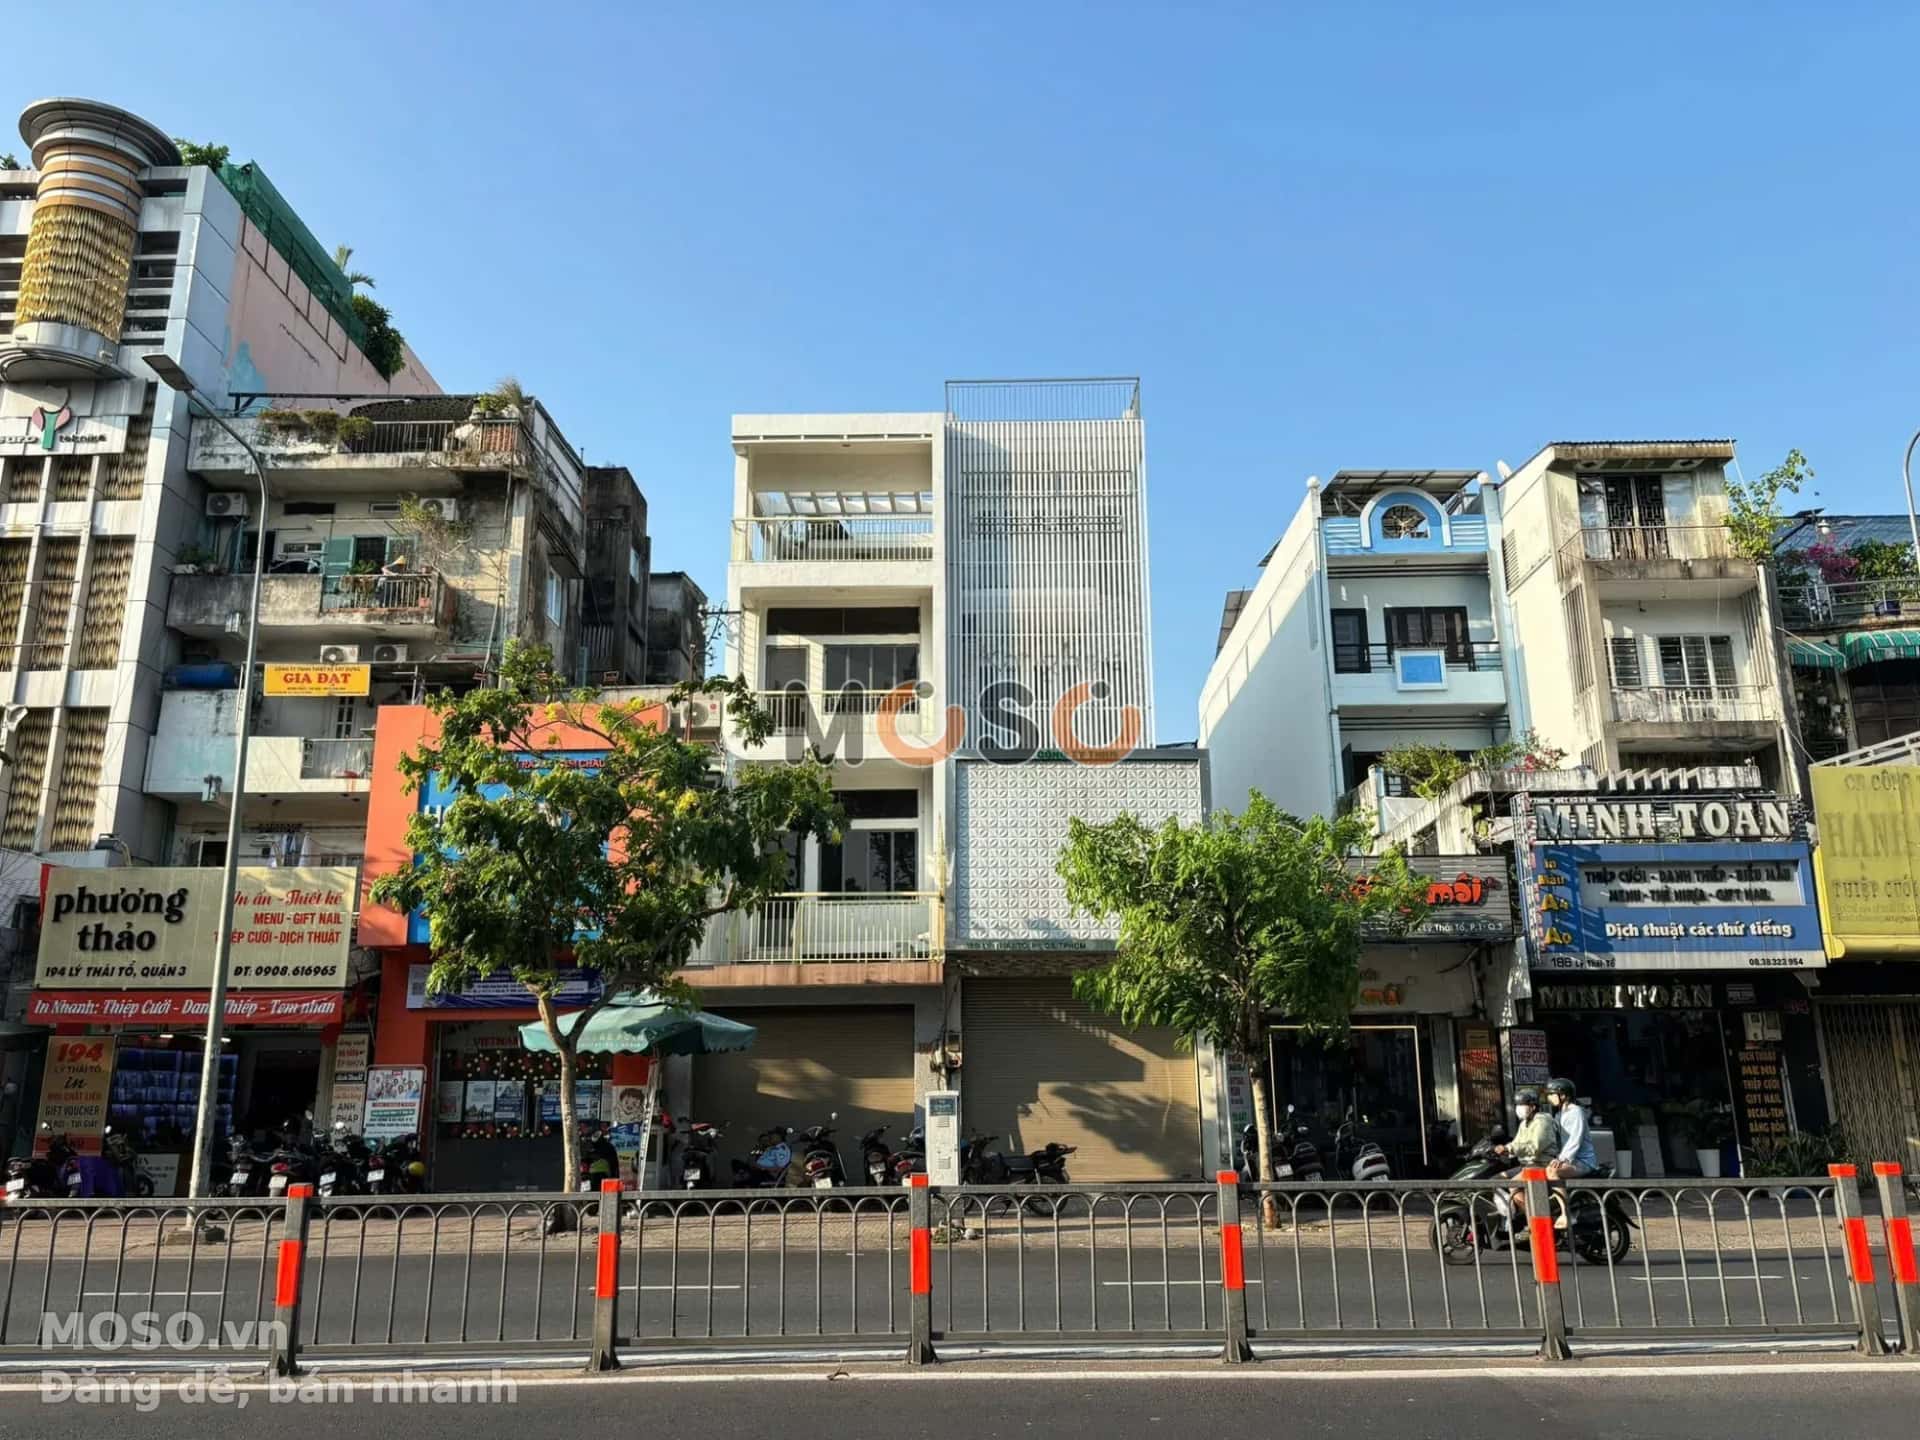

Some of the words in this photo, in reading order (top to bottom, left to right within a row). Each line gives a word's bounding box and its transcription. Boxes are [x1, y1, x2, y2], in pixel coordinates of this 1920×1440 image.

[283, 672, 312, 684] GIA
[317, 672, 351, 686] ĐẠT
[1535, 802, 1656, 839] MINH
[1658, 870, 1692, 883] DANH
[52, 885, 189, 923] phương
[253, 912, 285, 925] MENU
[293, 912, 316, 925] GIFT
[318, 912, 343, 925] NAIL
[76, 921, 156, 951] thảo
[279, 930, 304, 946] DỊCH
[307, 928, 342, 946] THUẬT
[1605, 922, 1639, 940] Dịch
[1643, 921, 1684, 940] thuật
[1689, 921, 1714, 937] các
[1718, 920, 1745, 937] thứ
[1750, 918, 1793, 939] tiếng
[45, 966, 66, 977] 194
[68, 964, 81, 977] LÝ
[86, 963, 115, 977] THÁI
[141, 962, 175, 980] QUẬN
[178, 966, 188, 977] 3
[255, 965, 337, 977] 0908.616965
[34, 999, 49, 1014] In
[51, 999, 100, 1014] Nhanh:
[103, 999, 139, 1018] Thiệp
[141, 998, 172, 1014] Cưới
[182, 998, 212, 1015] Dan
[57, 1042, 105, 1063] 194
